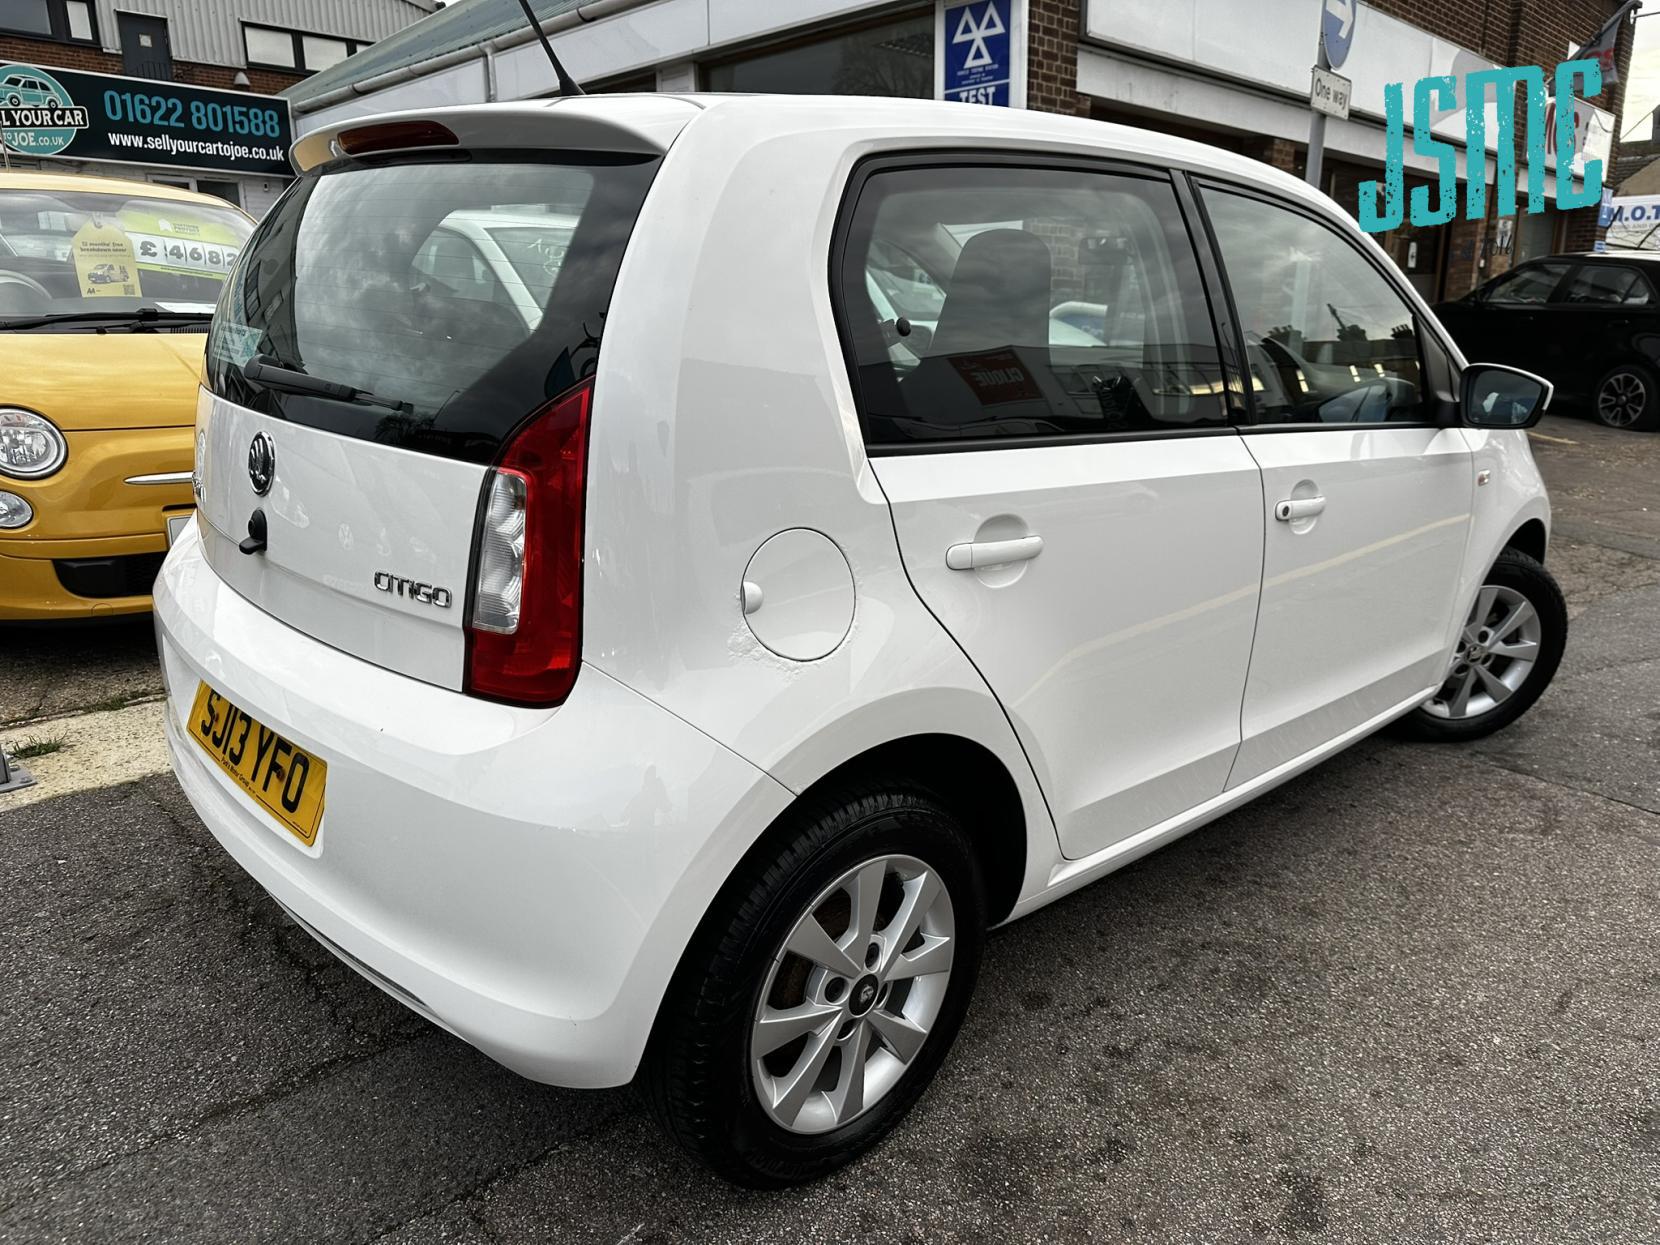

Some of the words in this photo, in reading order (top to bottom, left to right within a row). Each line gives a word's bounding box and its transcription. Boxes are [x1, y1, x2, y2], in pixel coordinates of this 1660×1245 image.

[960, 86, 996, 106] TEST
[1315, 78, 1331, 101] One
[1332, 89, 1348, 110] way
[11, 110, 53, 126] YOUR
[53, 110, 84, 126] CAR
[104, 90, 185, 128] 01622
[190, 101, 280, 138] 801588
[107, 132, 285, 162] www.sellyourcartojoe.co.uk
[374, 571, 453, 608] CITIGO
[200, 688, 252, 766] SJ13
[251, 724, 310, 814] YFO
